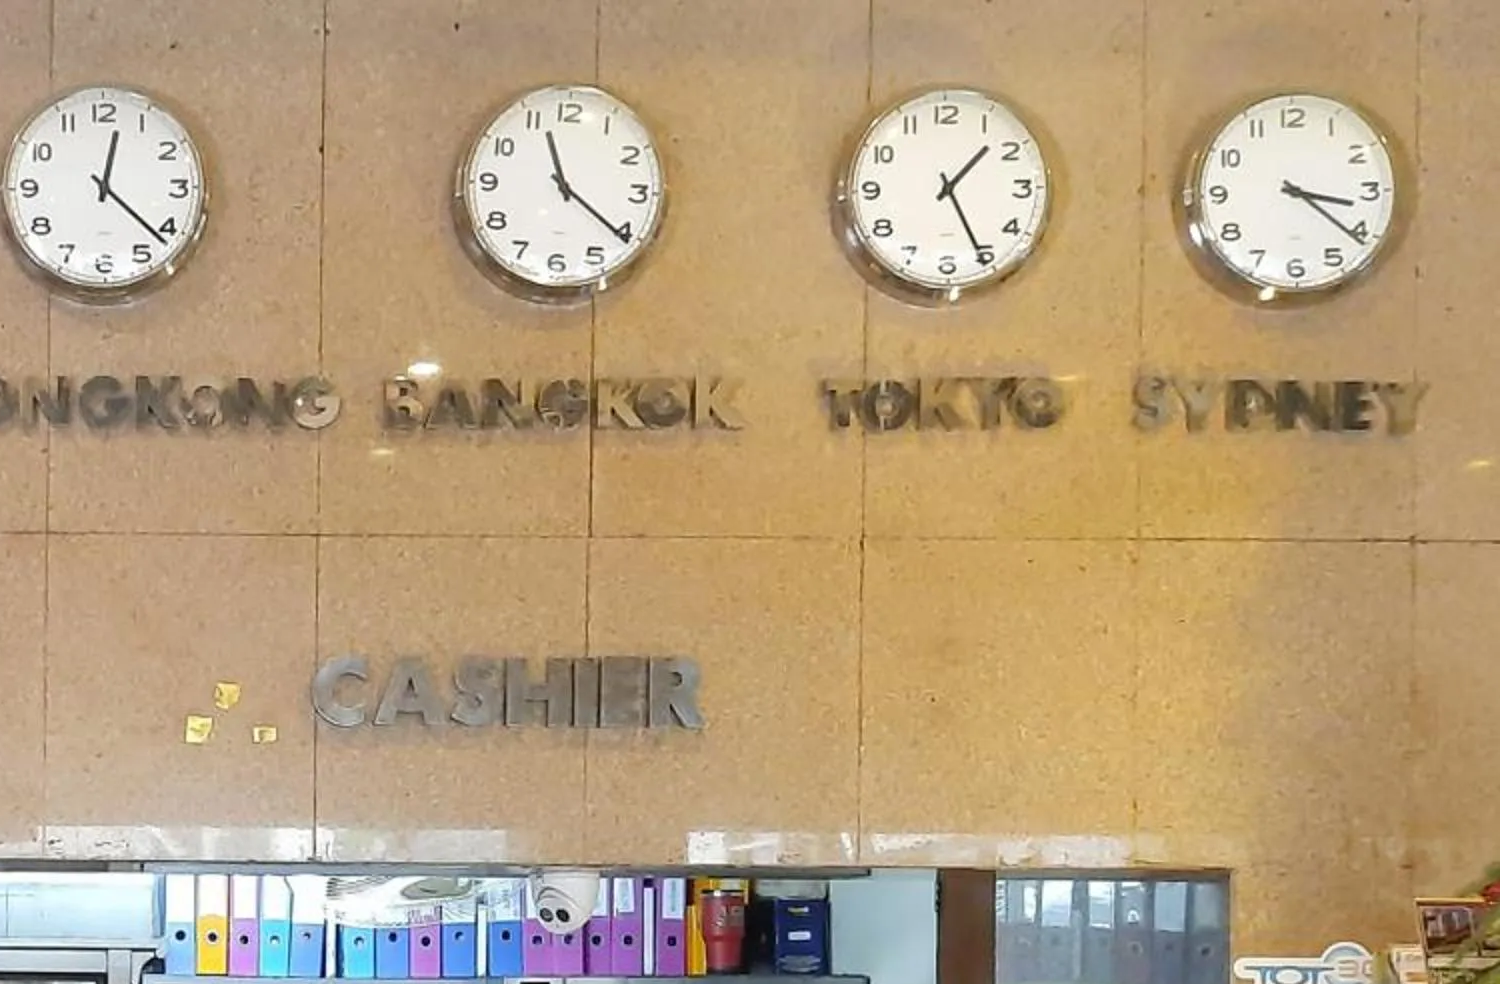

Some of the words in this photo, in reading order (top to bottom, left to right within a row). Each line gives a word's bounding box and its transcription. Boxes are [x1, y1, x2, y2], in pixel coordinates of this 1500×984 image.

[92, 104, 116, 123] 12
[526, 110, 540, 129] 11
[557, 103, 582, 122] 12
[934, 106, 958, 125] 12
[1281, 109, 1305, 128] 12
[61, 113, 75, 132] 11
[140, 114, 144, 132] 1
[604, 116, 610, 135] 1
[903, 116, 916, 135] 11
[982, 114, 987, 134] 1
[1250, 120, 1263, 138] 11
[1329, 118, 1333, 136] 1
[33, 143, 52, 162] 10
[158, 142, 177, 160] 2
[494, 138, 514, 157] 10
[620, 146, 640, 165] 2
[874, 146, 893, 164] 10
[1002, 142, 1020, 161] 2
[1348, 145, 1366, 164] 2
[1221, 149, 1240, 168] 10
[20, 180, 39, 198] 9
[168, 180, 189, 199] 3
[479, 173, 498, 191] 9
[862, 181, 880, 200] 9
[1012, 180, 1032, 199] 3
[1360, 182, 1380, 201] 3
[628, 185, 648, 203] 3
[1209, 186, 1228, 204] 9
[31, 217, 51, 235] 8
[159, 217, 177, 236] 4
[486, 212, 506, 230] 8
[873, 219, 893, 237] 8
[1002, 219, 1020, 236] 4
[1221, 223, 1241, 241] 8
[58, 244, 75, 263] 7
[132, 244, 152, 263] 5
[512, 241, 528, 259] 7
[585, 247, 604, 265] 5
[1250, 250, 1266, 268] 7
[1324, 248, 1343, 266] 5
[547, 254, 566, 272] 6
[1286, 259, 1305, 278] 6
[382, 376, 744, 431] BANGKOK
[819, 377, 1064, 431] TOKYO
[1132, 377, 1429, 435] SYDNEY
[311, 653, 708, 729] CASHIER
